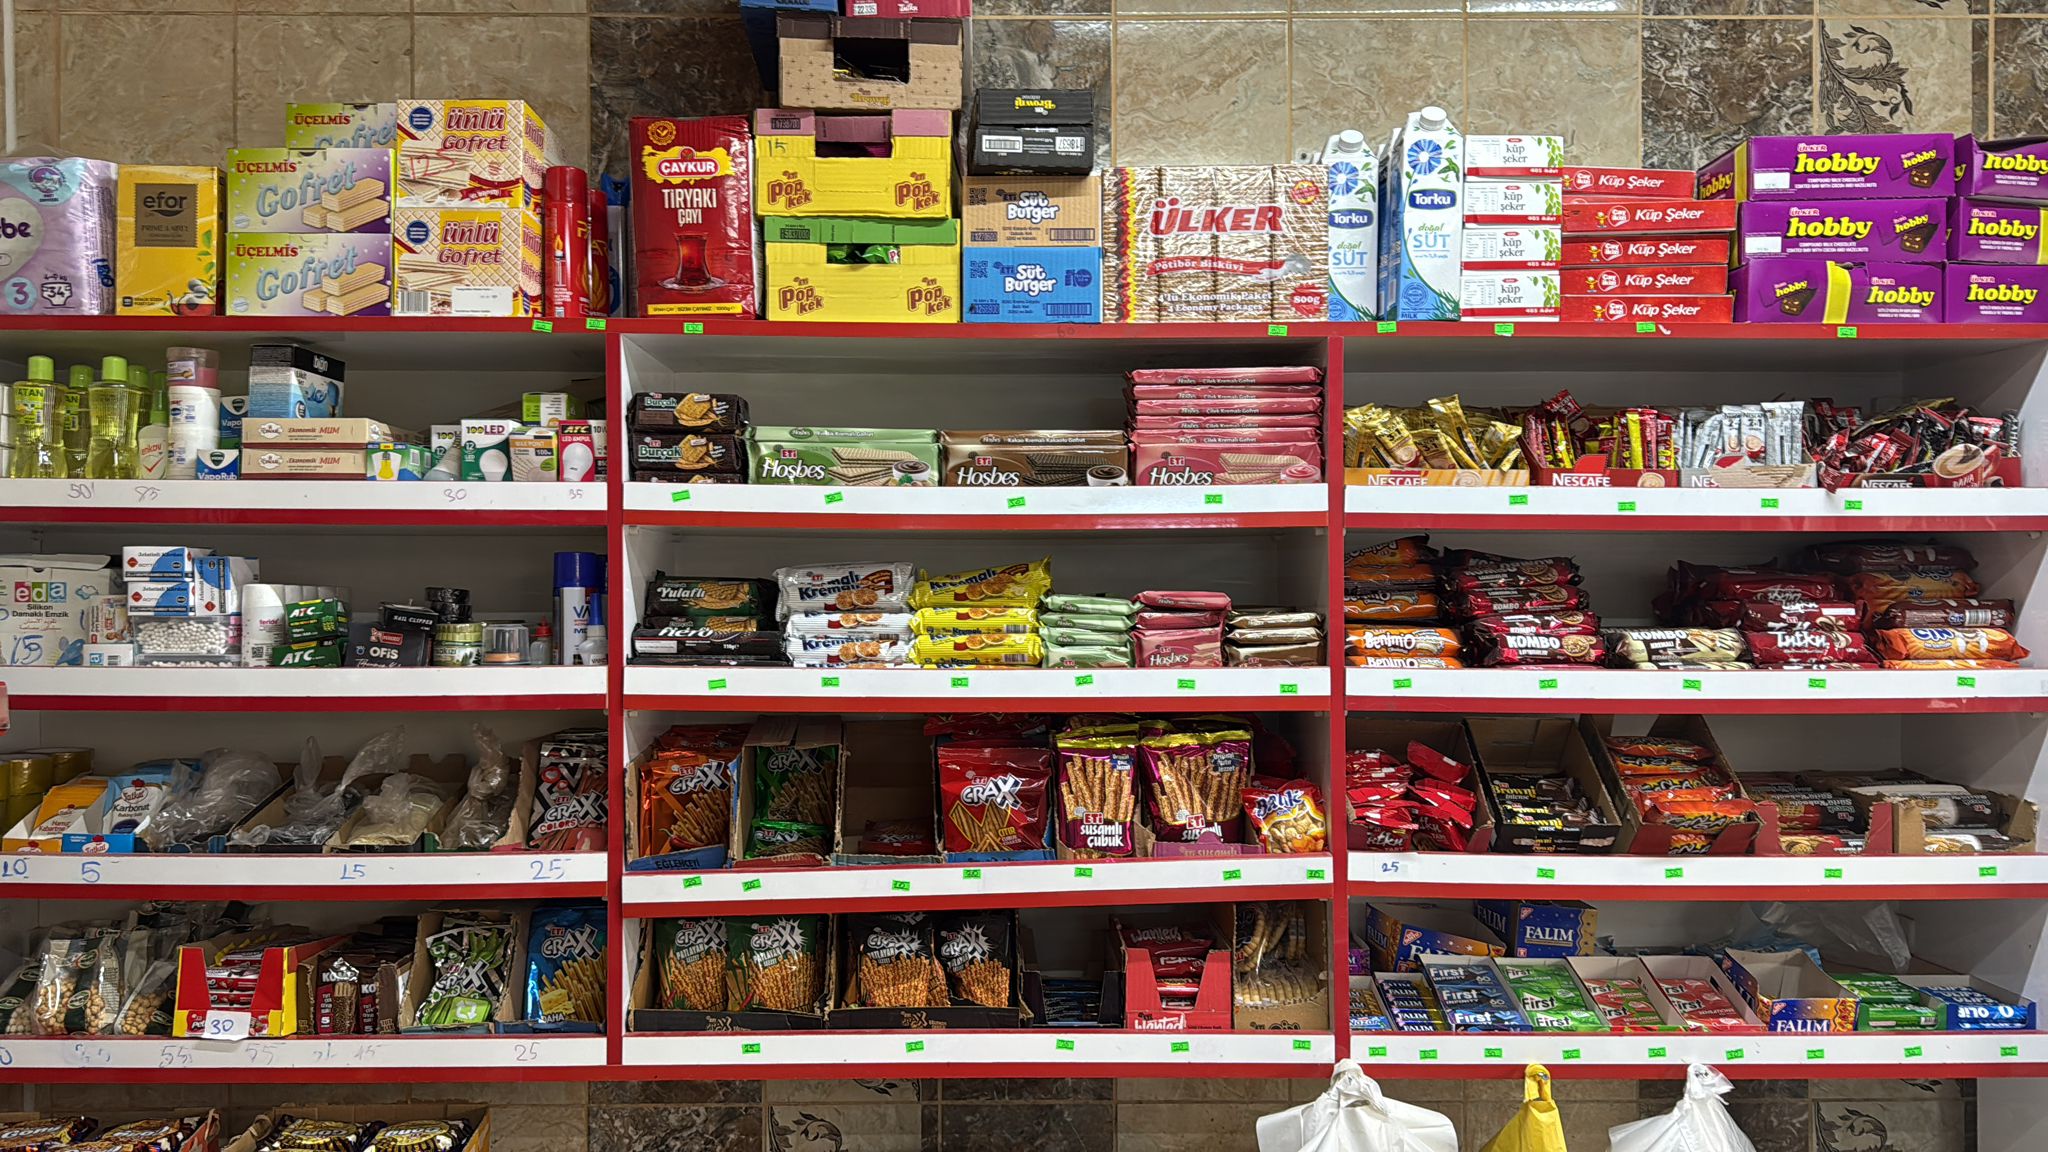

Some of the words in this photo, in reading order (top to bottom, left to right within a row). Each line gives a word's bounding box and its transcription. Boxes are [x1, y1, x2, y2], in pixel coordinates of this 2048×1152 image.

[445, 105, 506, 132] ünlü
[441, 133, 509, 152] Gofret
[1794, 152, 1881, 175] hobby
[1902, 149, 1937, 169] hobby
[257, 159, 357, 217] Gofret
[1599, 175, 1617, 188] Küp
[1621, 175, 1665, 189] Şeker
[143, 192, 187, 209] efor
[1414, 191, 1452, 206] Torku
[1007, 203, 1060, 223] Burger
[1149, 197, 1284, 236] ÜLKER
[1332, 212, 1369, 225] Torku
[1635, 208, 1656, 222] Küp
[1665, 207, 1704, 222] Şeker
[441, 220, 500, 244] ünlü
[1786, 217, 1873, 239] hobby
[1894, 214, 1929, 233] hobby
[1968, 218, 2038, 239] hobby
[1412, 232, 1452, 248] SÜT
[438, 247, 503, 266] Gofret
[1332, 249, 1368, 266] SÜT
[1627, 243, 1649, 256] Küp
[1657, 243, 1697, 257] Şeker
[257, 243, 358, 301] Gofret
[1005, 275, 1056, 295] Burger
[1625, 275, 1646, 287] Küp
[1655, 274, 1693, 288] Şeker
[1775, 280, 1808, 297] hobby
[13, 282, 30, 304] 3
[47, 285, 66, 299] 34
[1866, 285, 1936, 307] hobby
[1968, 284, 2038, 304] hobby
[1632, 303, 1654, 316] Küp
[1662, 303, 1700, 318] Şeker
[639, 446, 681, 459] Burçak
[761, 460, 825, 480] Hoşbeş
[956, 467, 1020, 486] Hoşbeş
[1150, 467, 1212, 486] Hoşbeş
[15, 582, 67, 602] eda
[656, 587, 705, 599] Yulaflı
[12, 610, 46, 618] Damaklı
[47, 610, 69, 618] Emzik
[27, 603, 54, 611] Silikon
[1506, 635, 1561, 649] KOMBO
[112, 802, 150, 812] Karbonat
[538, 818, 578, 833] COLORS
[1080, 822, 1123, 838] susamlı
[1087, 833, 1124, 849] çubuk
[81, 861, 102, 883] 5
[530, 859, 566, 880] 25
[1381, 861, 1400, 872] 25
[1525, 925, 1574, 943] FALIM
[1429, 966, 1465, 979] First
[1442, 988, 1478, 1002] First
[1522, 995, 1555, 1009] First
[1454, 1010, 1491, 1024] First
[1536, 1015, 1571, 1028] First
[1776, 1019, 1829, 1032] FALIM
[210, 1019, 234, 1035] 30
